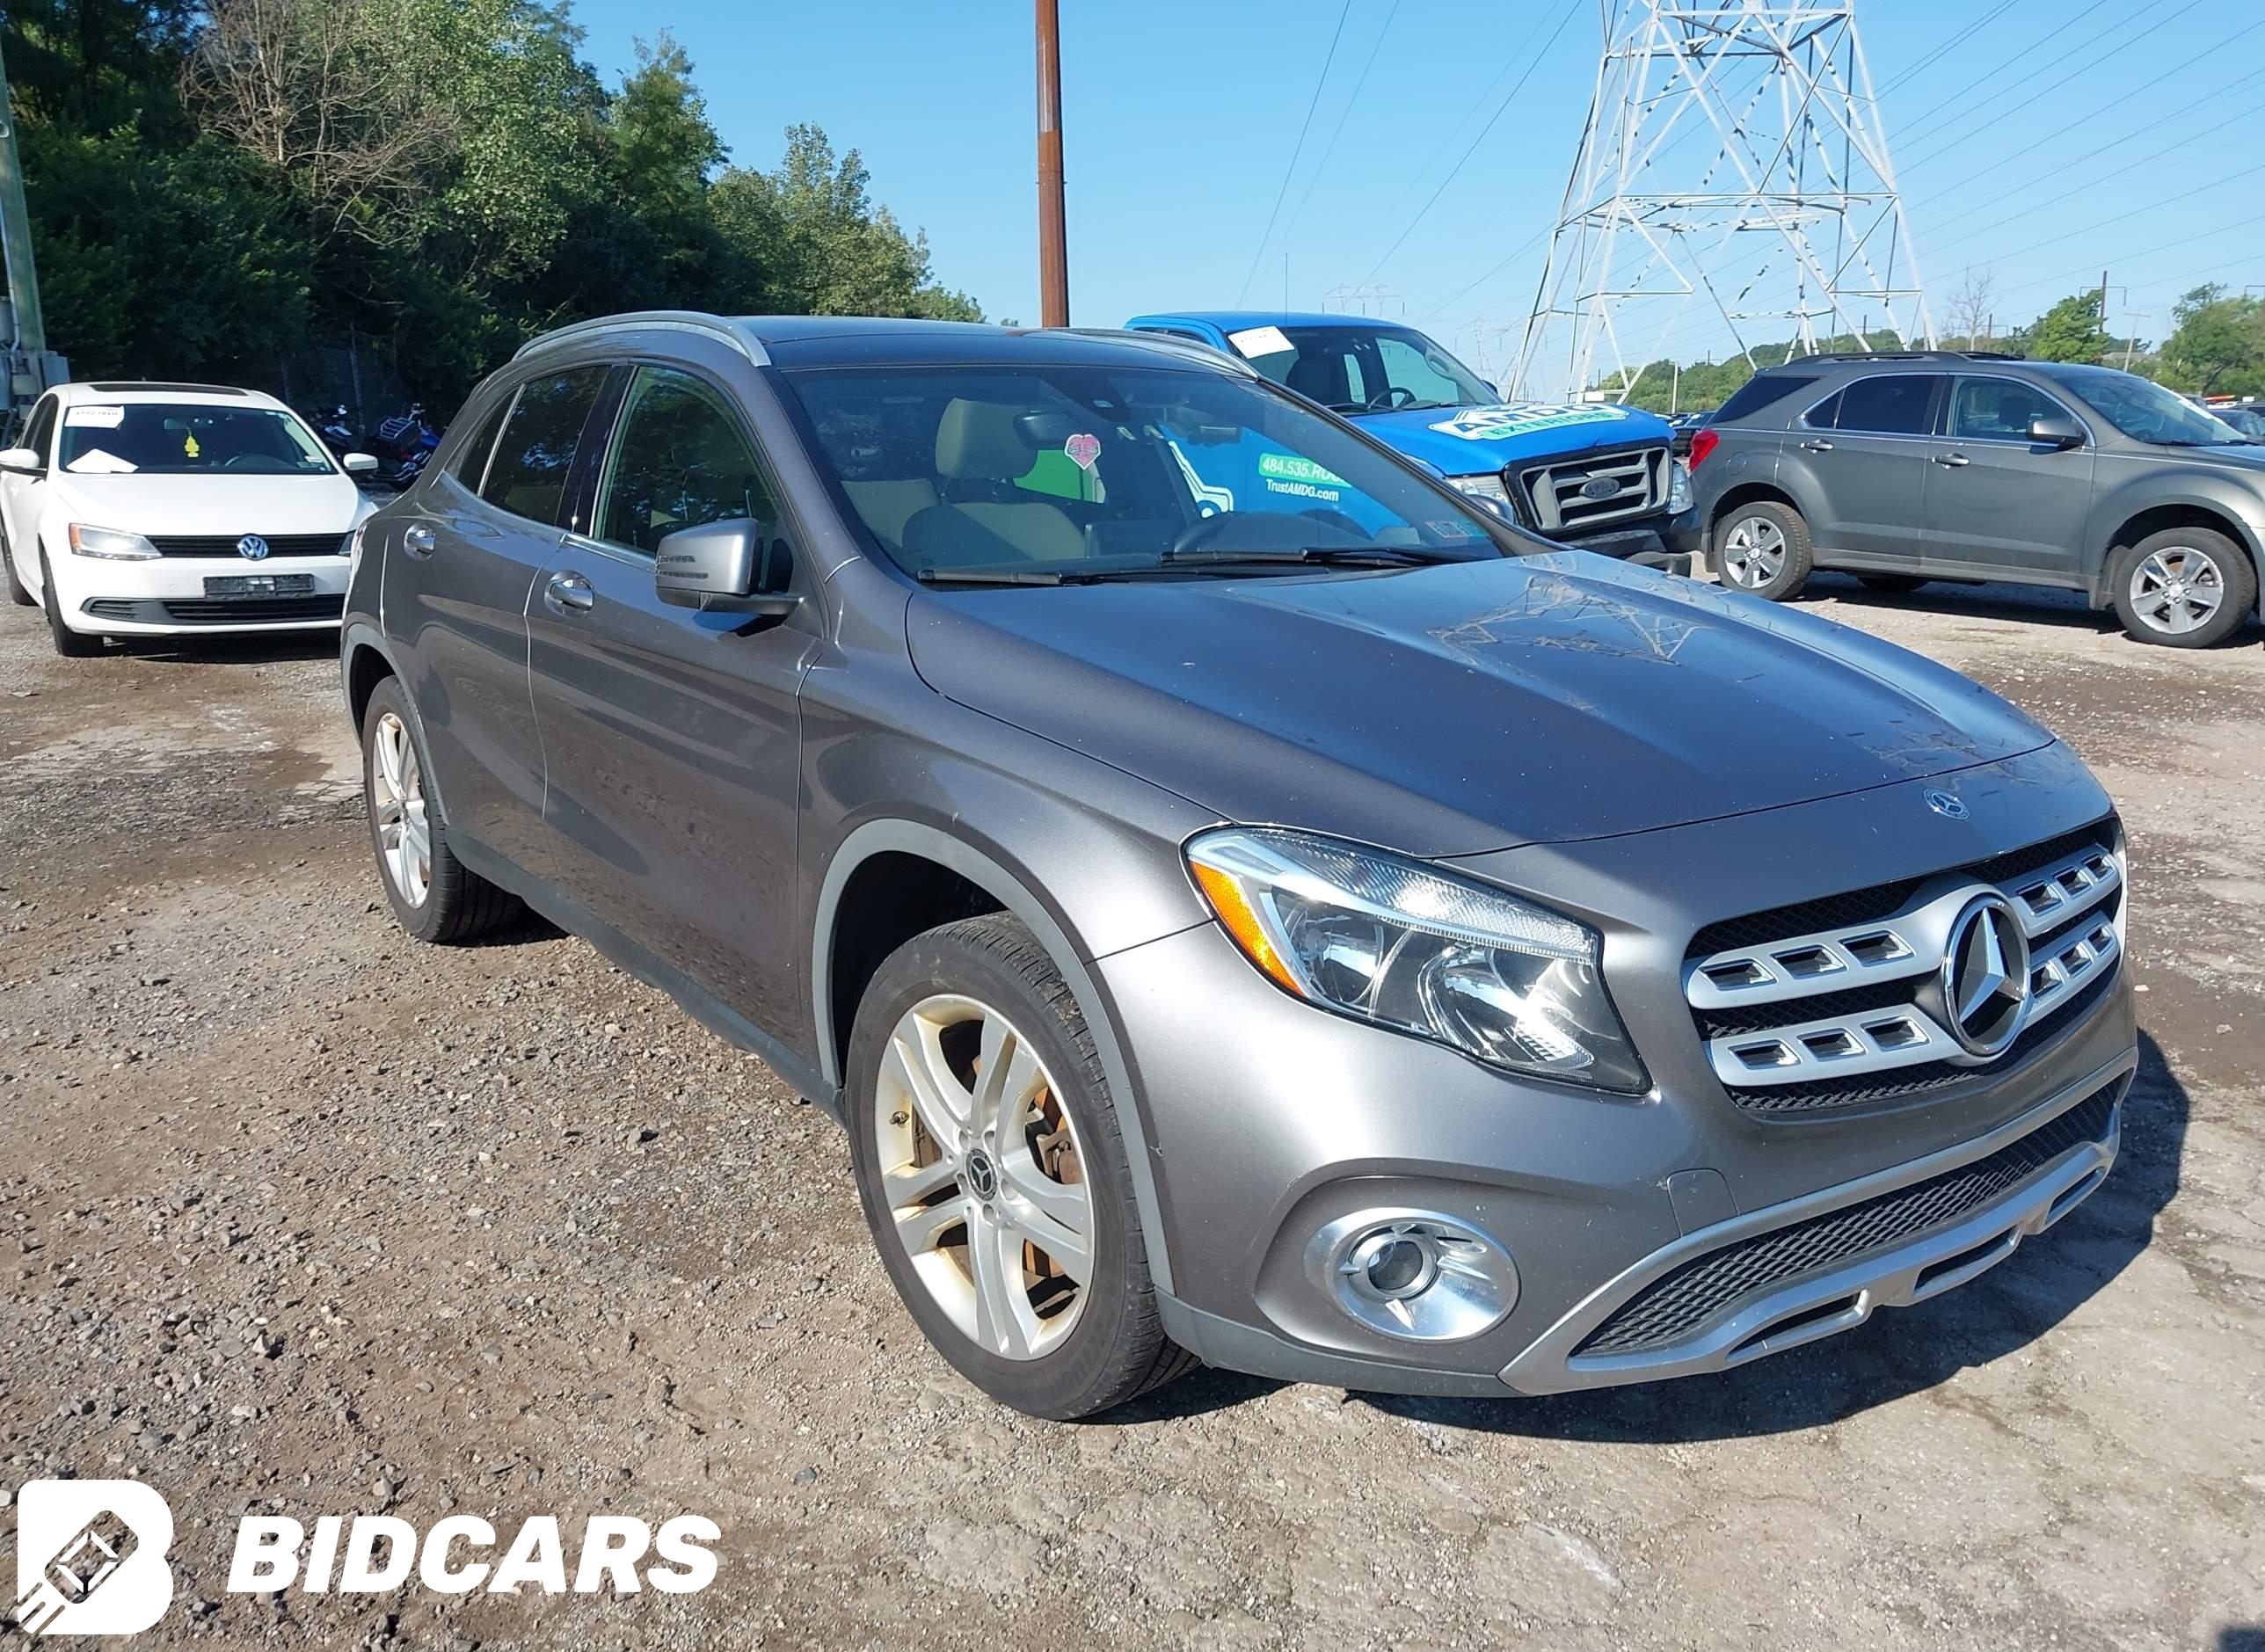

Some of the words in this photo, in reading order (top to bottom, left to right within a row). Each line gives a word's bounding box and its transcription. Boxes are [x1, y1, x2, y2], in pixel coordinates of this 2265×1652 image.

[1453, 404, 1606, 433] AMDG
[1490, 411, 1613, 436] EXTERIORS
[1262, 456, 1345, 483] 484.535.RO
[1266, 478, 1339, 501] TrustAMDG.com
